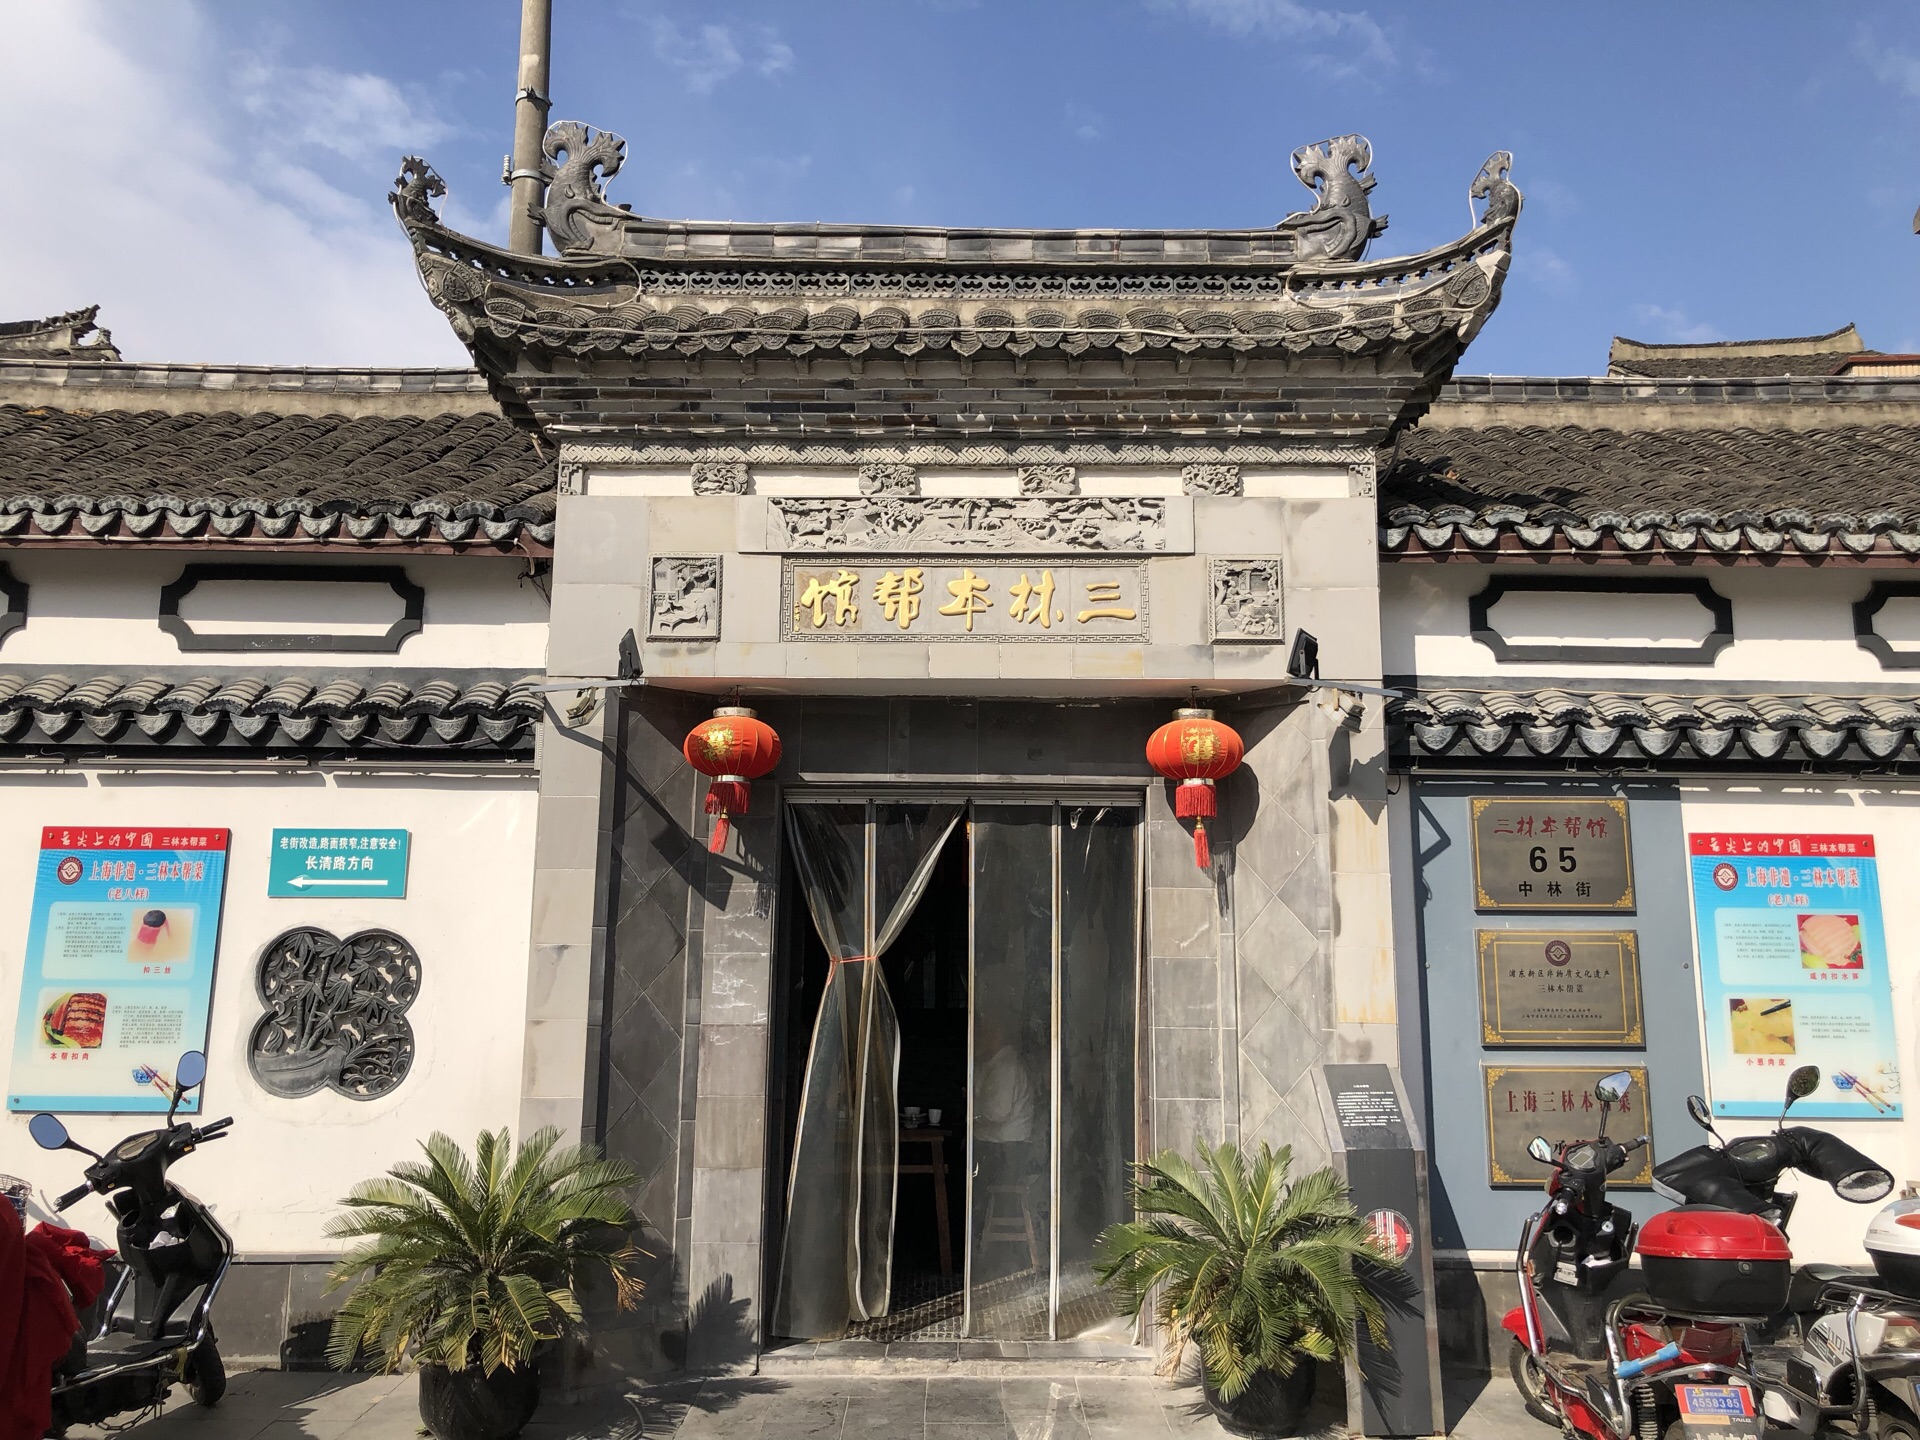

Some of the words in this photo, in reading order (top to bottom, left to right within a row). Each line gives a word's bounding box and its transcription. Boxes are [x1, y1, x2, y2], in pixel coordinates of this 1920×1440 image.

[1494, 815, 1609, 839] 三林本帮馆
[161, 836, 208, 847] 三林本帮菜
[1810, 843, 1857, 854] 三林本帮菜
[305, 856, 374, 871] 长清路方向
[1529, 846, 1577, 873] 65
[1518, 881, 1591, 897] 中林街
[1508, 969, 1611, 979] 浦东新区非物质文化遗产
[50, 1052, 89, 1061] 本帮扣肉
[1693, 1399, 1740, 1408] 4558385
